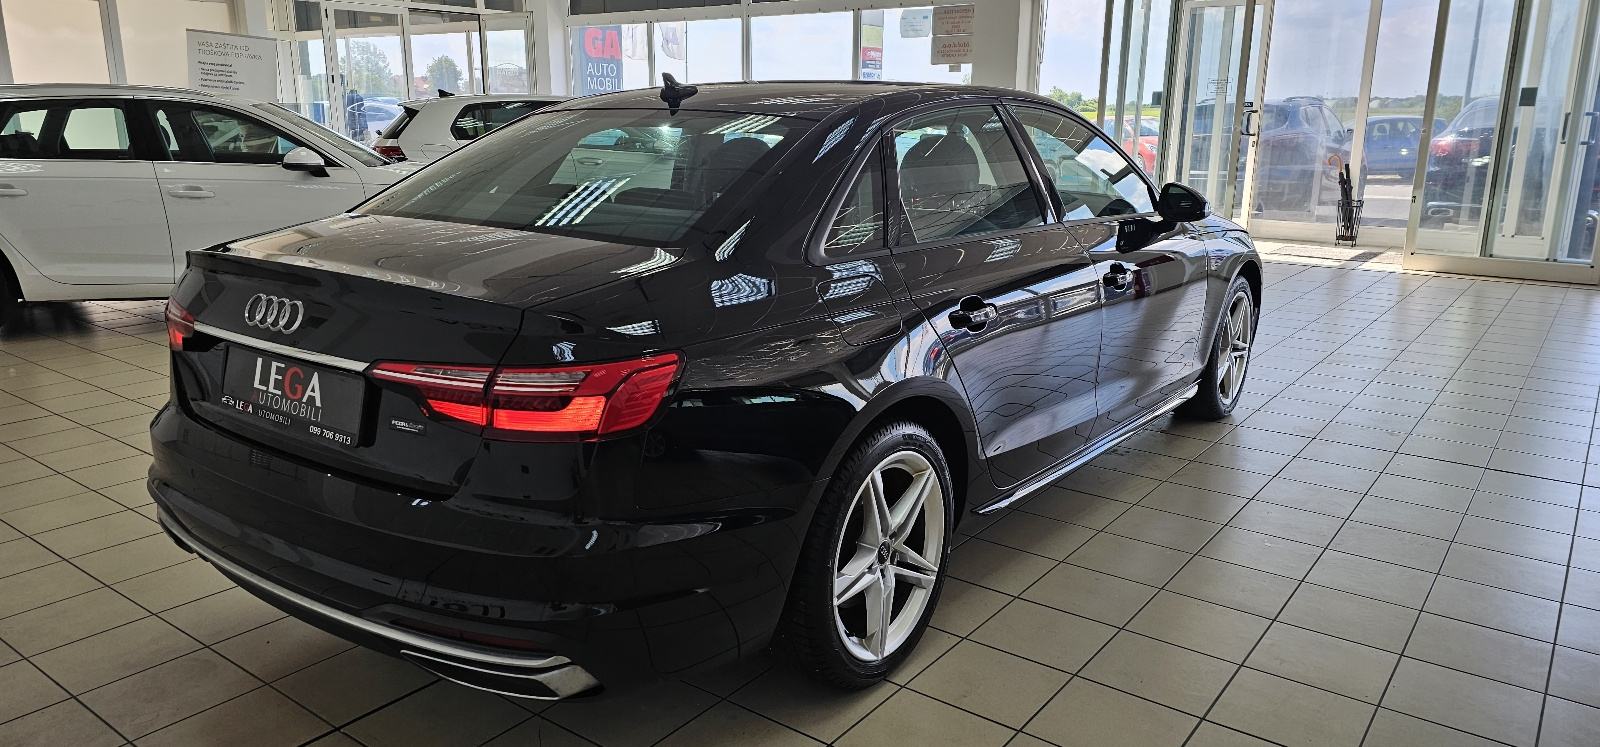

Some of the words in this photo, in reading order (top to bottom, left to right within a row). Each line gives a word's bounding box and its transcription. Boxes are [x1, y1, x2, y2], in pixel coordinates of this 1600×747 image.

[584, 27, 622, 61] GA
[586, 63, 617, 77] AUTO
[253, 357, 322, 408] LEGA
[235, 399, 253, 414] LEGA
[322, 429, 334, 440] 706
[334, 433, 352, 445] 9313
